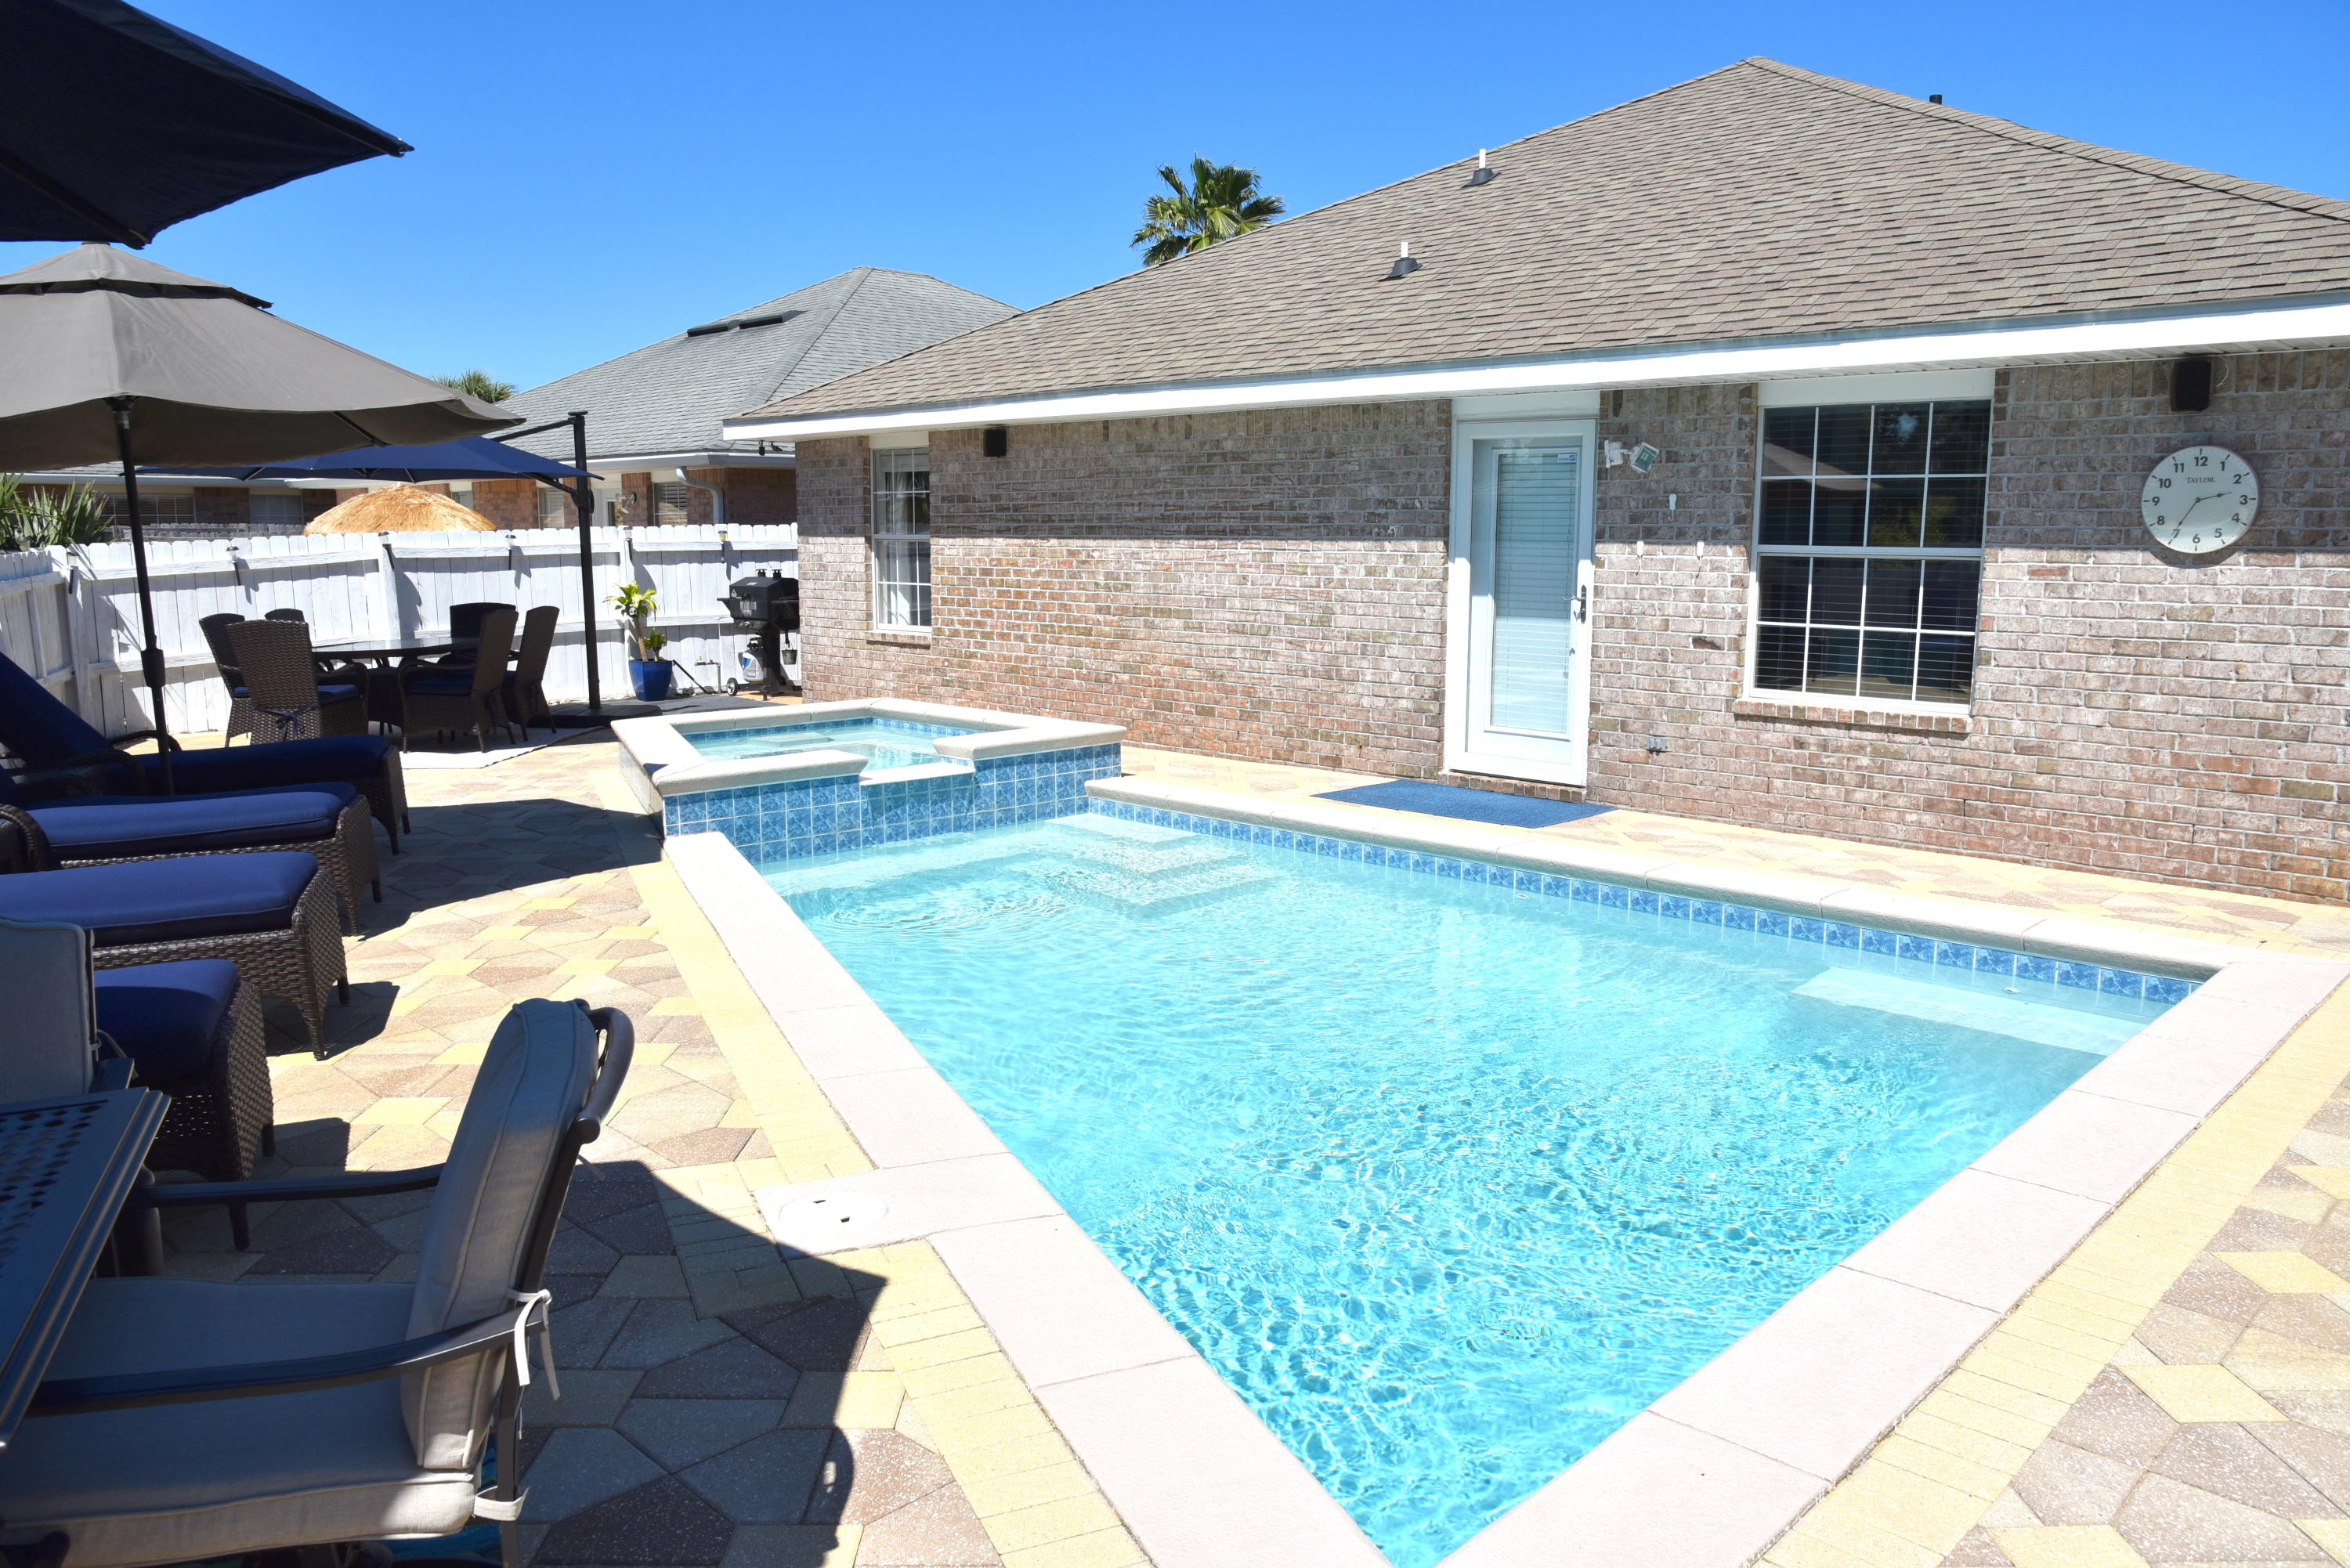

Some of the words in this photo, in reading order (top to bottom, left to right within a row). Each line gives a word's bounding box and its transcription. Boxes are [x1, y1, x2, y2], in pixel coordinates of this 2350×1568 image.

[2194, 456, 2208, 467] 12
[2220, 461, 2225, 471] 1
[2173, 463, 2185, 473] 11
[2159, 478, 2171, 488] 10
[2233, 474, 2242, 484] 2
[2152, 497, 2160, 506] 9
[2240, 495, 2248, 505] 3
[2157, 515, 2165, 526] 8
[2231, 513, 2240, 523] 4
[2173, 528, 2181, 539] 7
[2214, 528, 2222, 538] 5
[2193, 533, 2200, 544] 6
